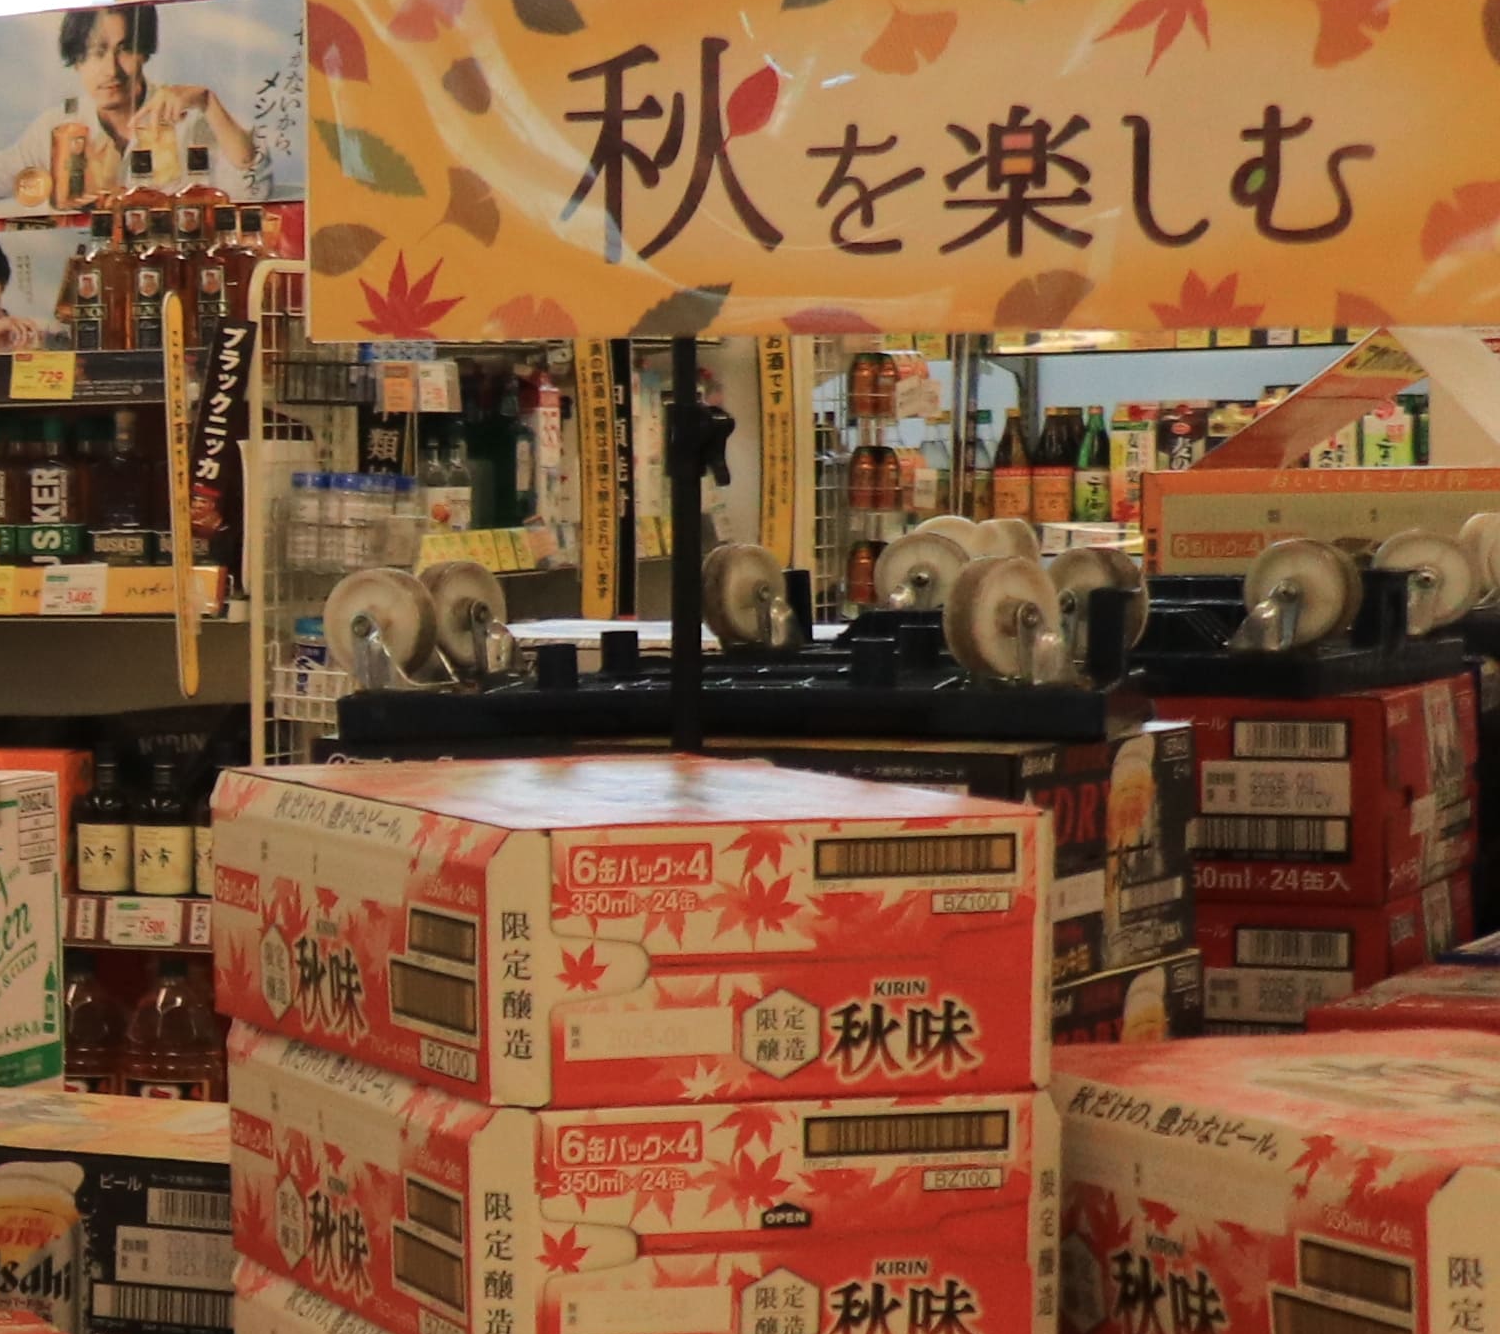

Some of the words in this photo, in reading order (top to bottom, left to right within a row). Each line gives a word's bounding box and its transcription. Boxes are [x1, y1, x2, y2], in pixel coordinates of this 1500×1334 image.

[560, 36, 1376, 265] 秋を楽しむ
[194, 326, 246, 479] ブラックニッカ
[941, 892, 1000, 911] BZ100
[499, 912, 532, 1061] 限定醸造
[872, 979, 927, 998] KIRIN
[825, 1001, 981, 1077] 秋味
[764, 1210, 807, 1225] OPEN
